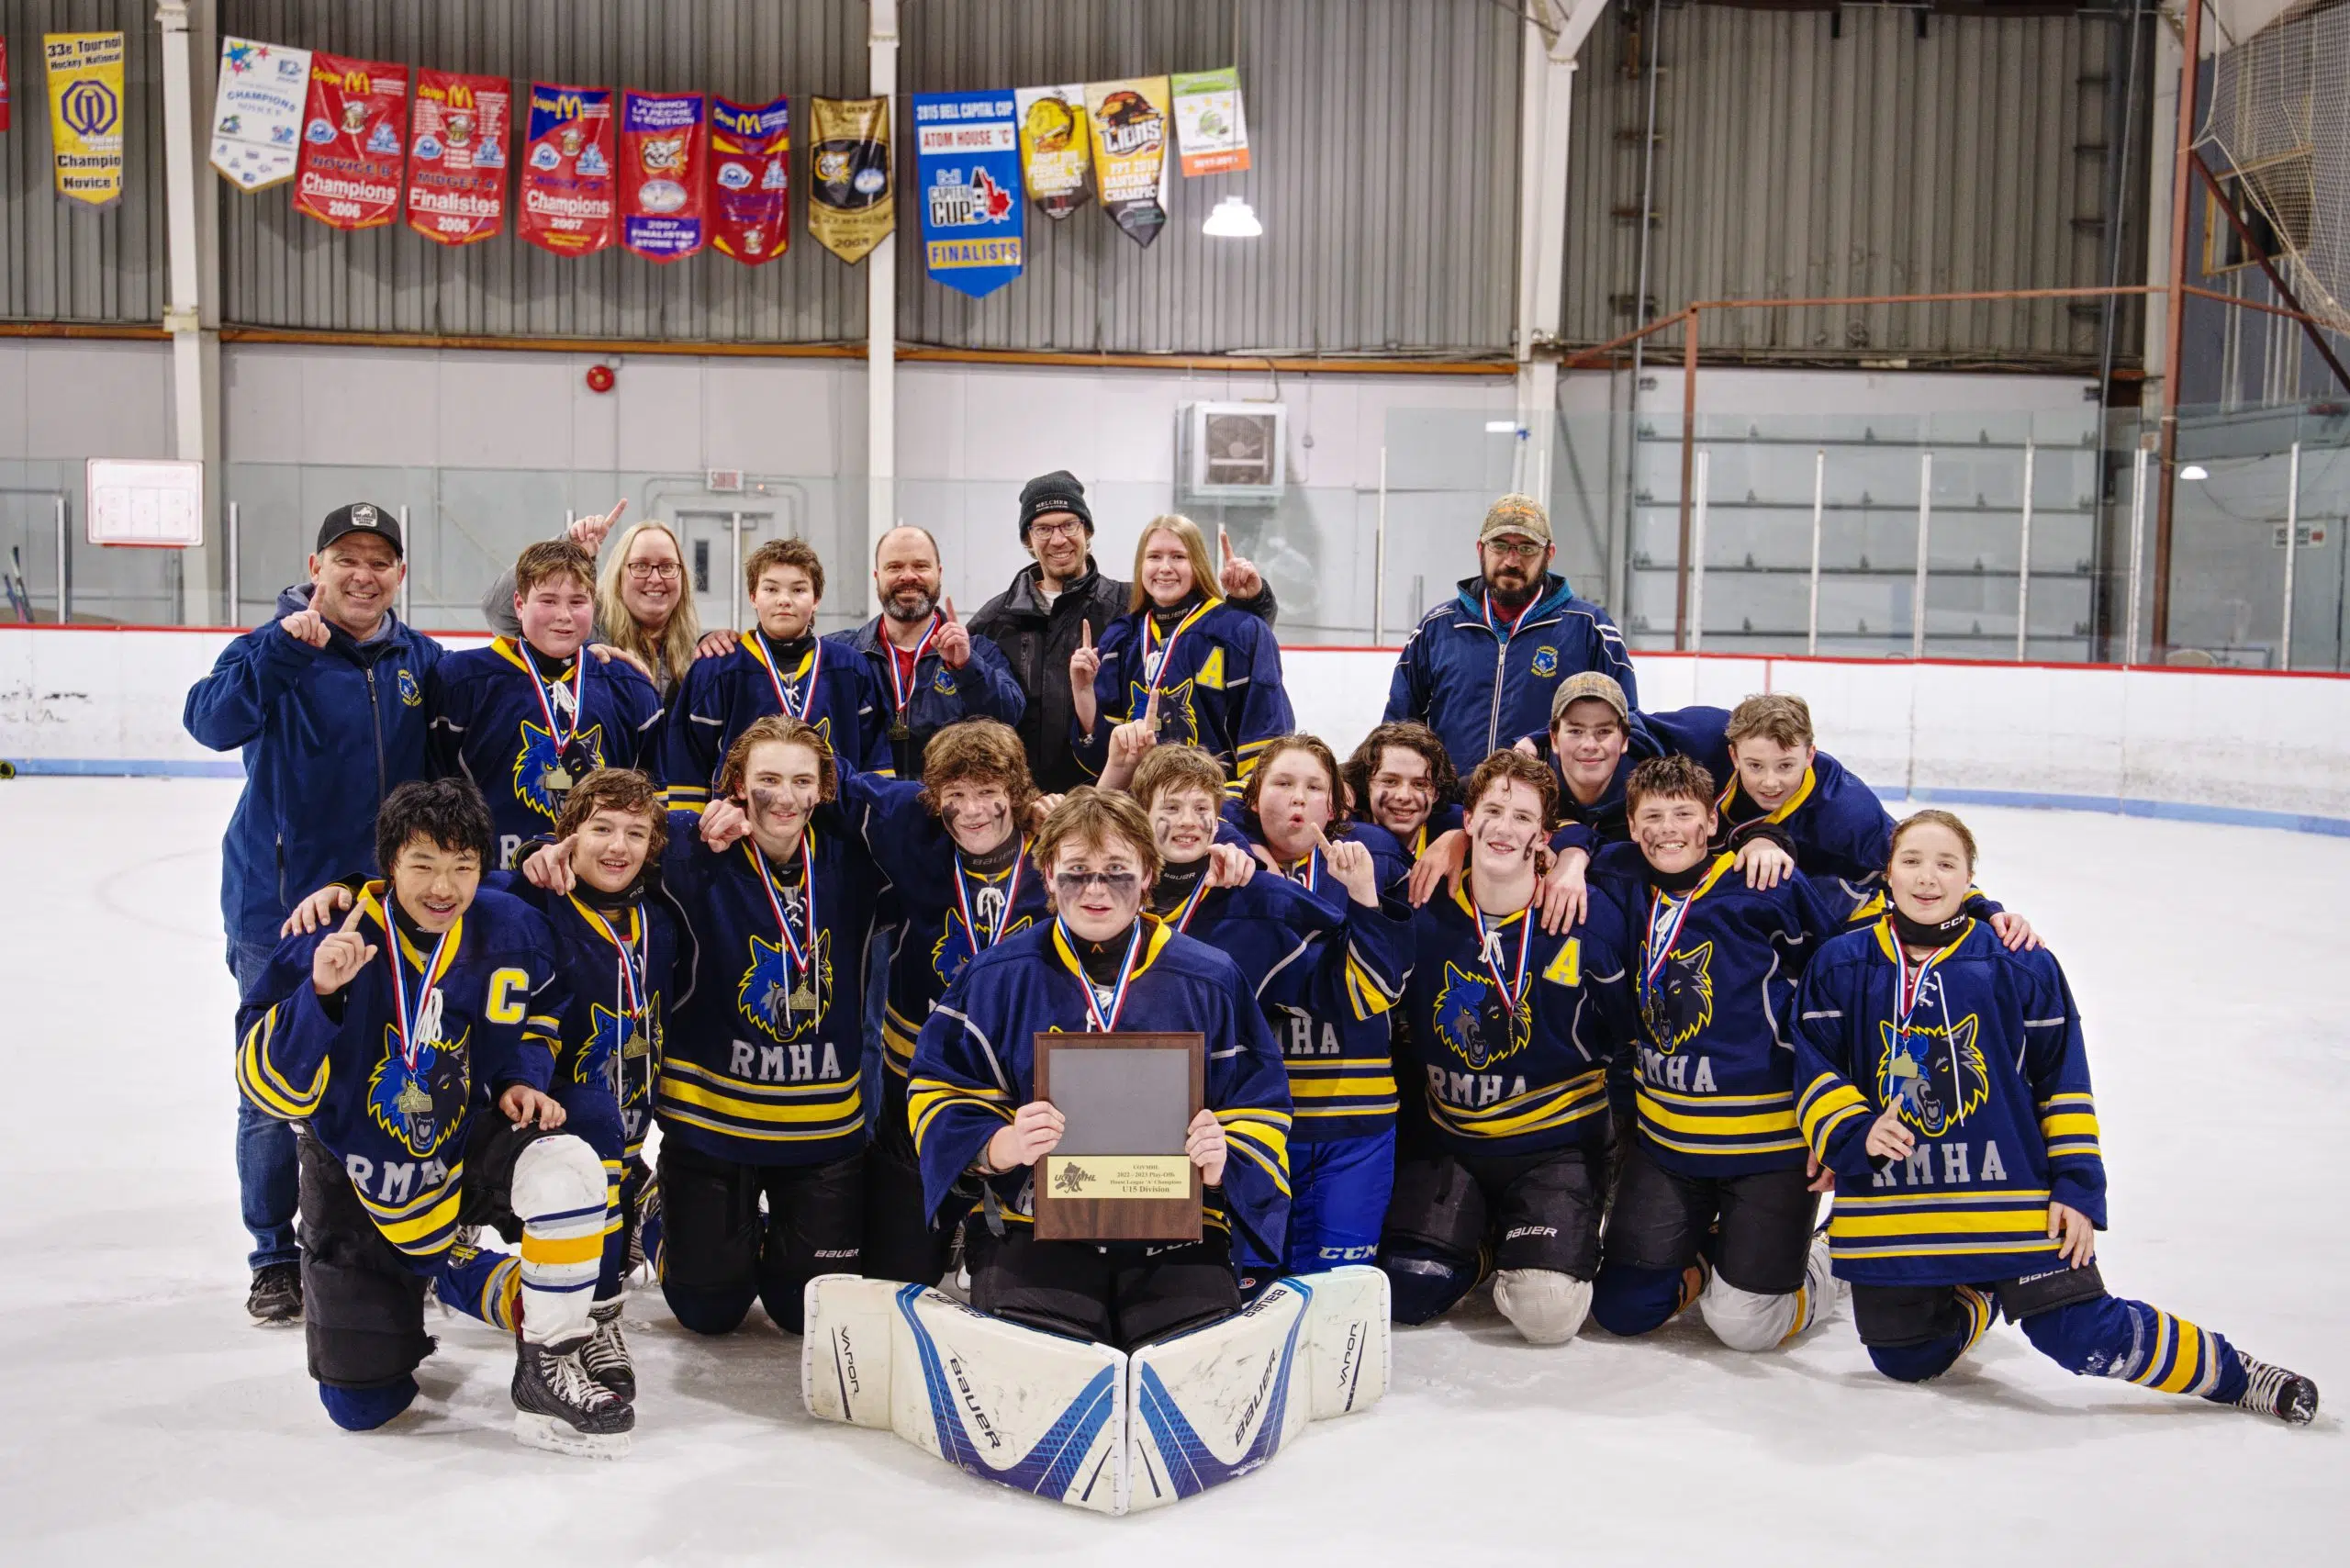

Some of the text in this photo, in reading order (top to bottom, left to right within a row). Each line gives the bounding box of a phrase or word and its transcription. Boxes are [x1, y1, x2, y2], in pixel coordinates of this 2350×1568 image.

[960, 102, 995, 118] CAPITAL
[995, 100, 1013, 117] CUP
[923, 131, 953, 147] ATOM
[957, 129, 991, 146] HOUSE
[301, 172, 397, 205] Champions
[526, 189, 610, 216] Champions
[932, 200, 971, 225] CUP
[932, 243, 1018, 264] FINALISTS
[1194, 645, 1225, 690] A
[1940, 913, 1965, 930] CCM
[1542, 936, 1583, 988] A
[485, 967, 530, 1025] C
[729, 1039, 842, 1081] RMHA
[1427, 1064, 1528, 1108] RMHA
[1318, 1242, 1380, 1260] CCM
[841, 1325, 860, 1401] VAPOR
[1337, 1320, 1360, 1389] VAPOR
